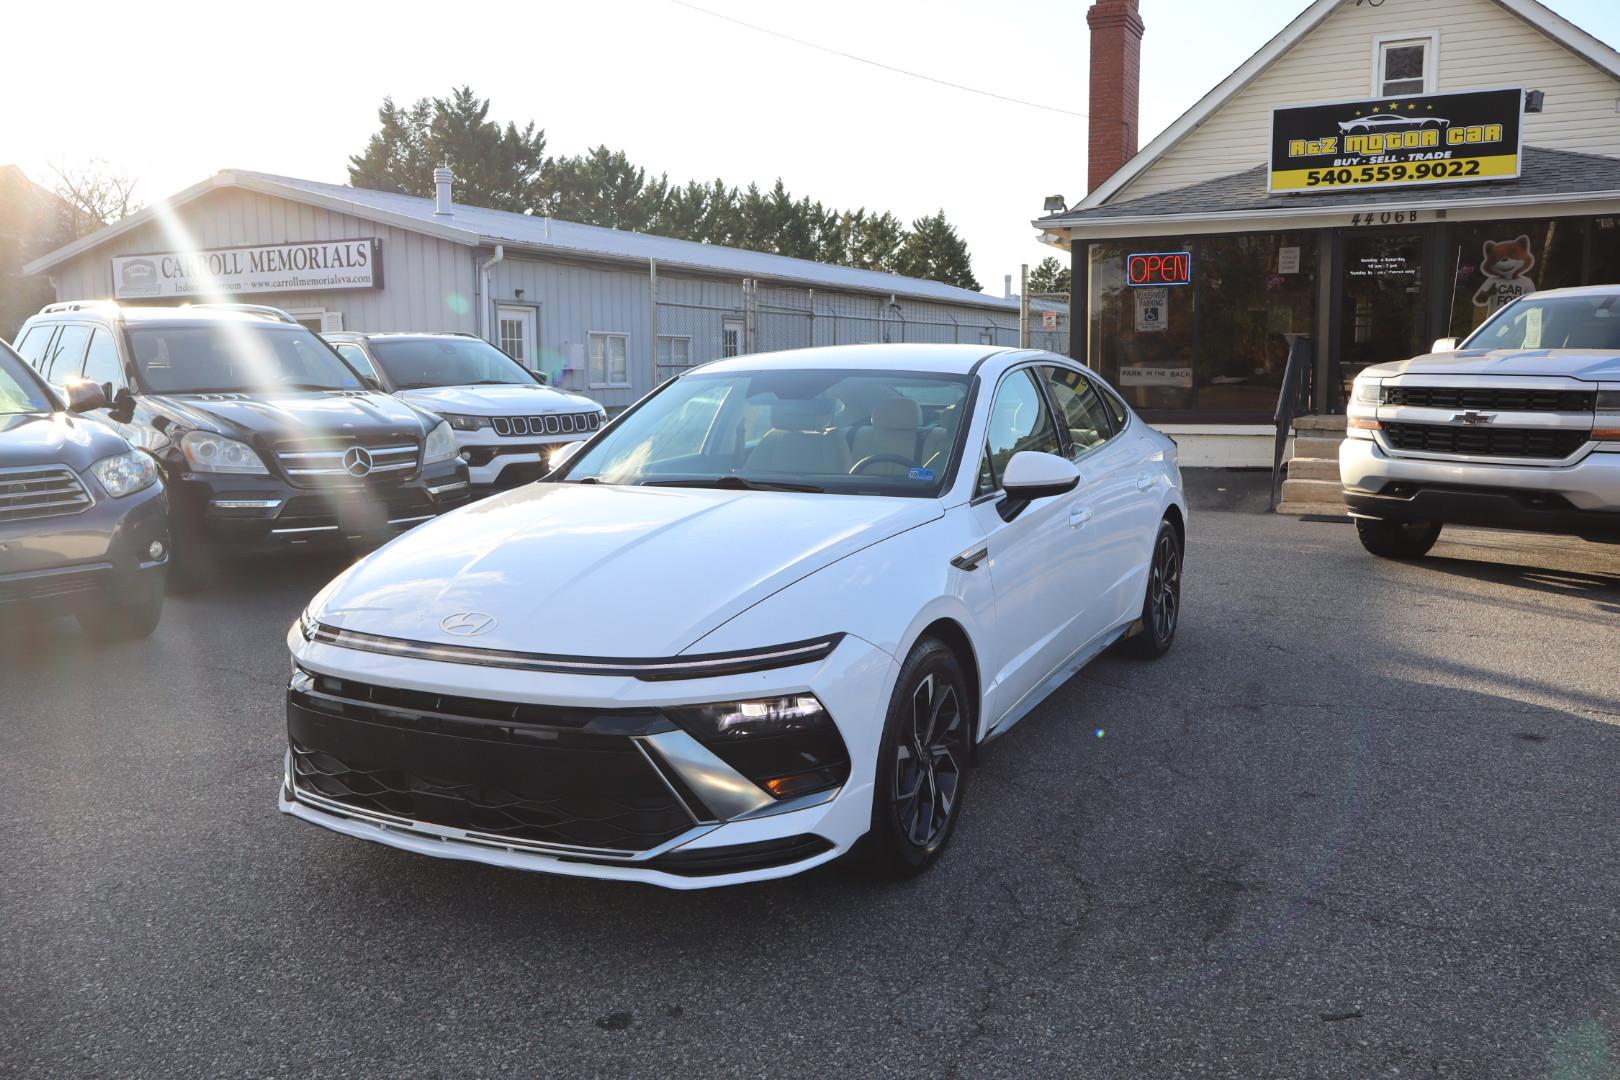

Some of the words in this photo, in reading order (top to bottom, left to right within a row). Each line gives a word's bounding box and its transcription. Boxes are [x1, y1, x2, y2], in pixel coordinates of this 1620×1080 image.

[1289, 137, 1337, 157] R&Z
[1333, 157, 1360, 167] BUY
[1369, 155, 1398, 164] SELL
[1408, 151, 1453, 162] TRADE
[1306, 159, 1480, 187] 540.559.9022
[1351, 211, 1417, 226] 4406B
[161, 252, 243, 279] CAOLL
[249, 243, 367, 273] MEMORIALS
[1130, 255, 1188, 283] OPEN
[251, 274, 371, 289] www.carrollmemorialsva.com
[1136, 290, 1166, 300] RESERVED
[1498, 284, 1522, 296] CAR
[1497, 295, 1518, 306] FO
